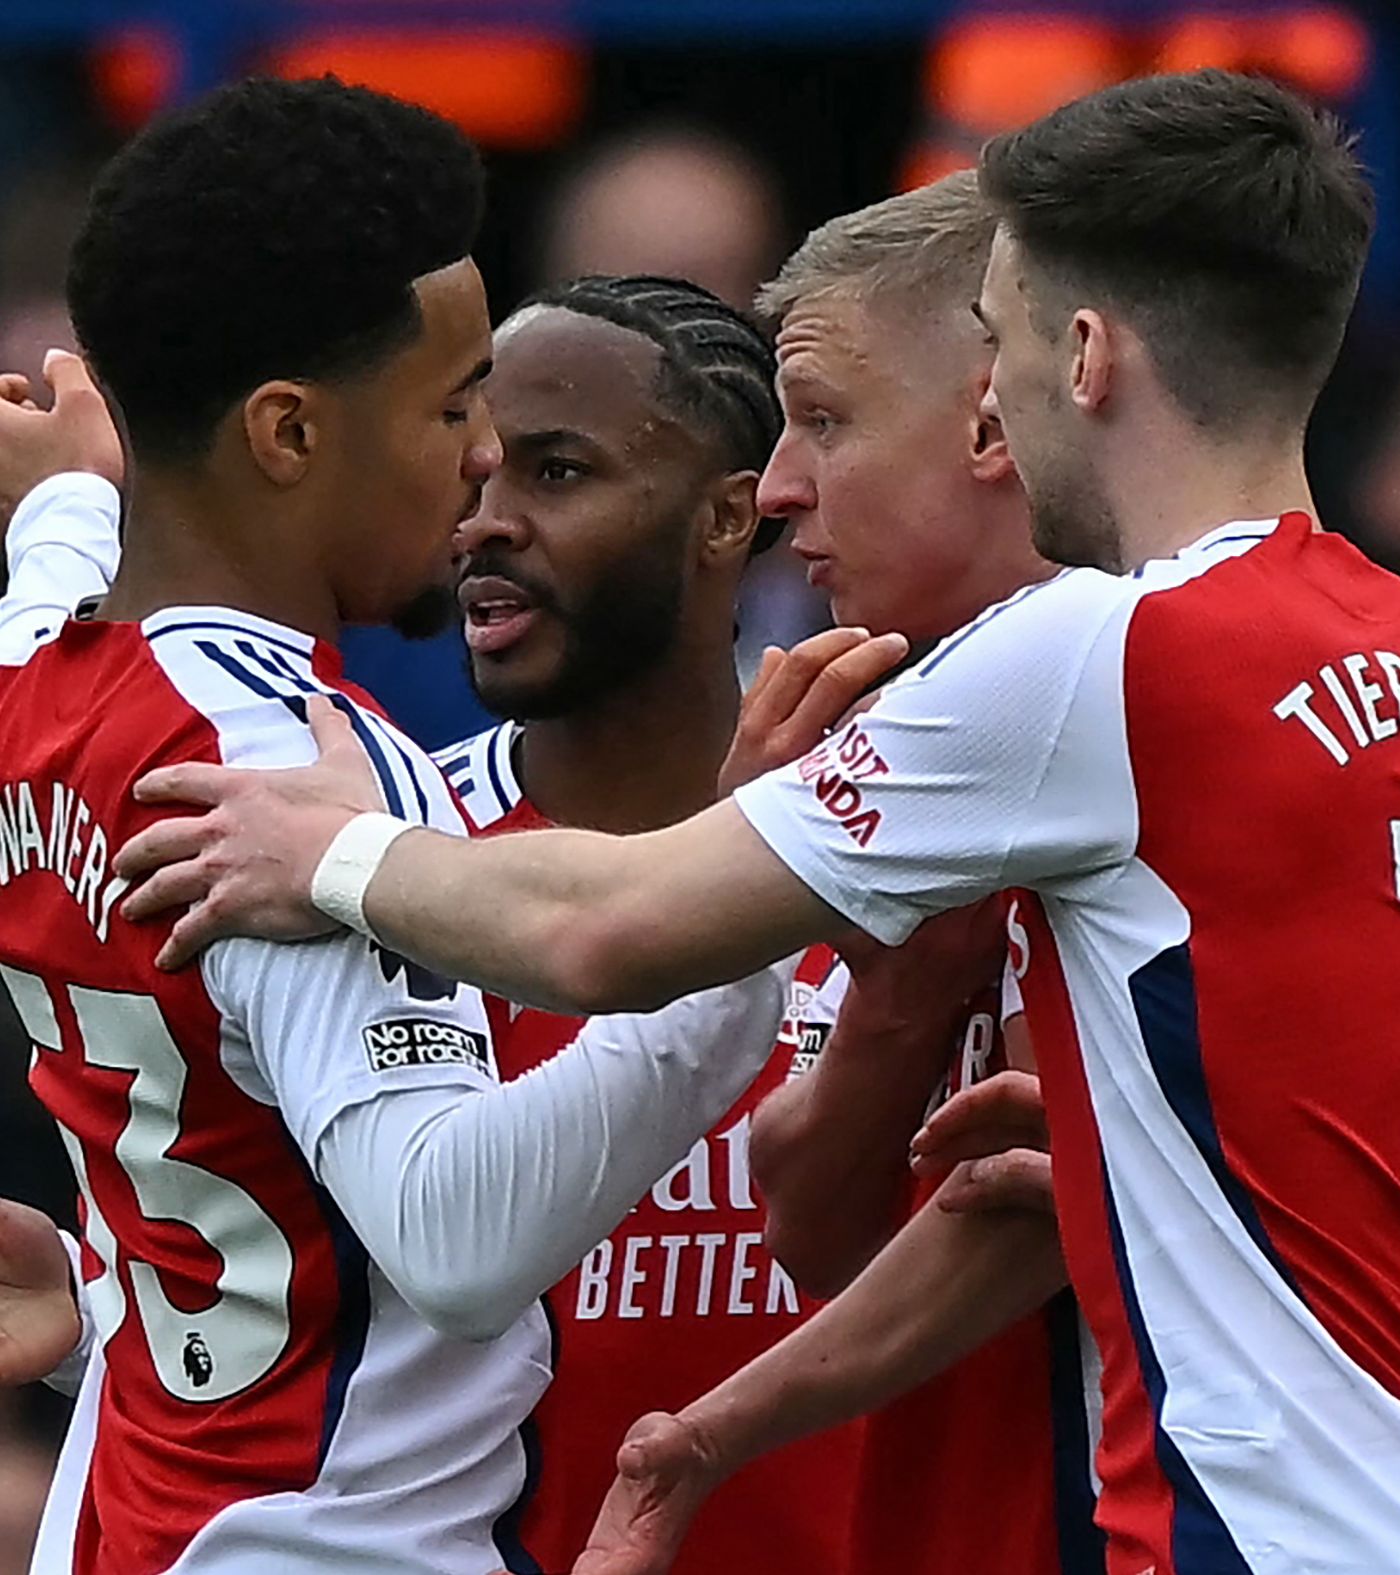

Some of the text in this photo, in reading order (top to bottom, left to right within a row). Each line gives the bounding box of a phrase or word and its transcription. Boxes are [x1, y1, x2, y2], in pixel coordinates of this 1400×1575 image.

[837, 722, 890, 781] ISIT
[364, 1023, 480, 1055] No room
[575, 1232, 801, 1320] BETTER
